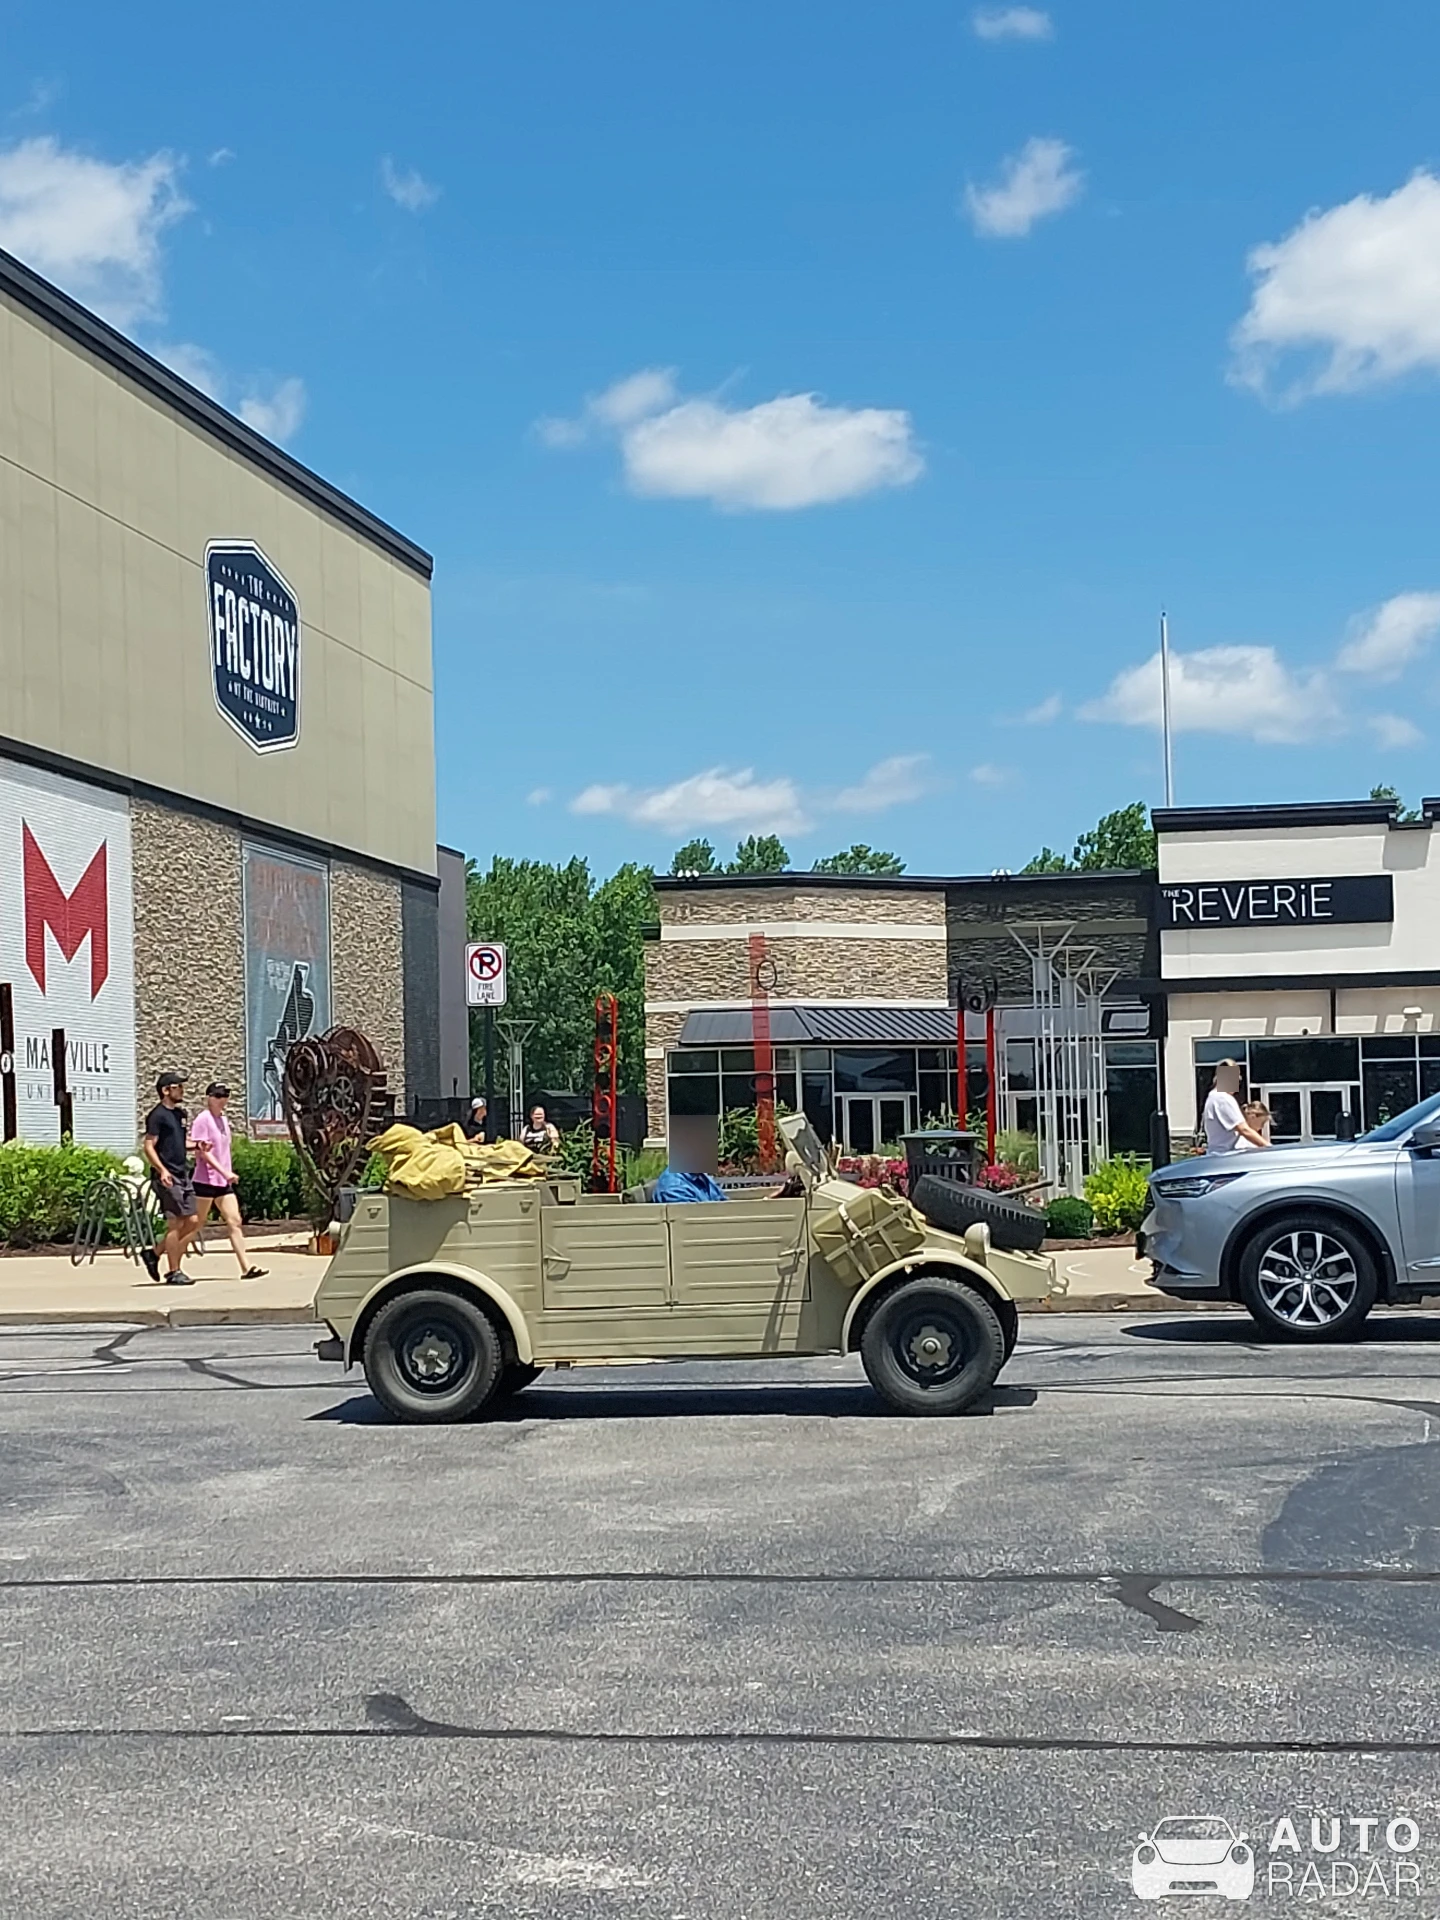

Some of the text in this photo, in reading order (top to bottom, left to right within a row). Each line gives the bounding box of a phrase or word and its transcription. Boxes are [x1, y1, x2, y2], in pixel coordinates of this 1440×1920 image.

[247, 574, 264, 600] THE
[213, 581, 296, 701] FACTORY
[1161, 889, 1181, 898] THE
[22, 816, 109, 1002] M
[477, 992, 495, 1000] LANE
[478, 983, 493, 991] FIRE
[26, 1036, 110, 1074] MAVILLE
